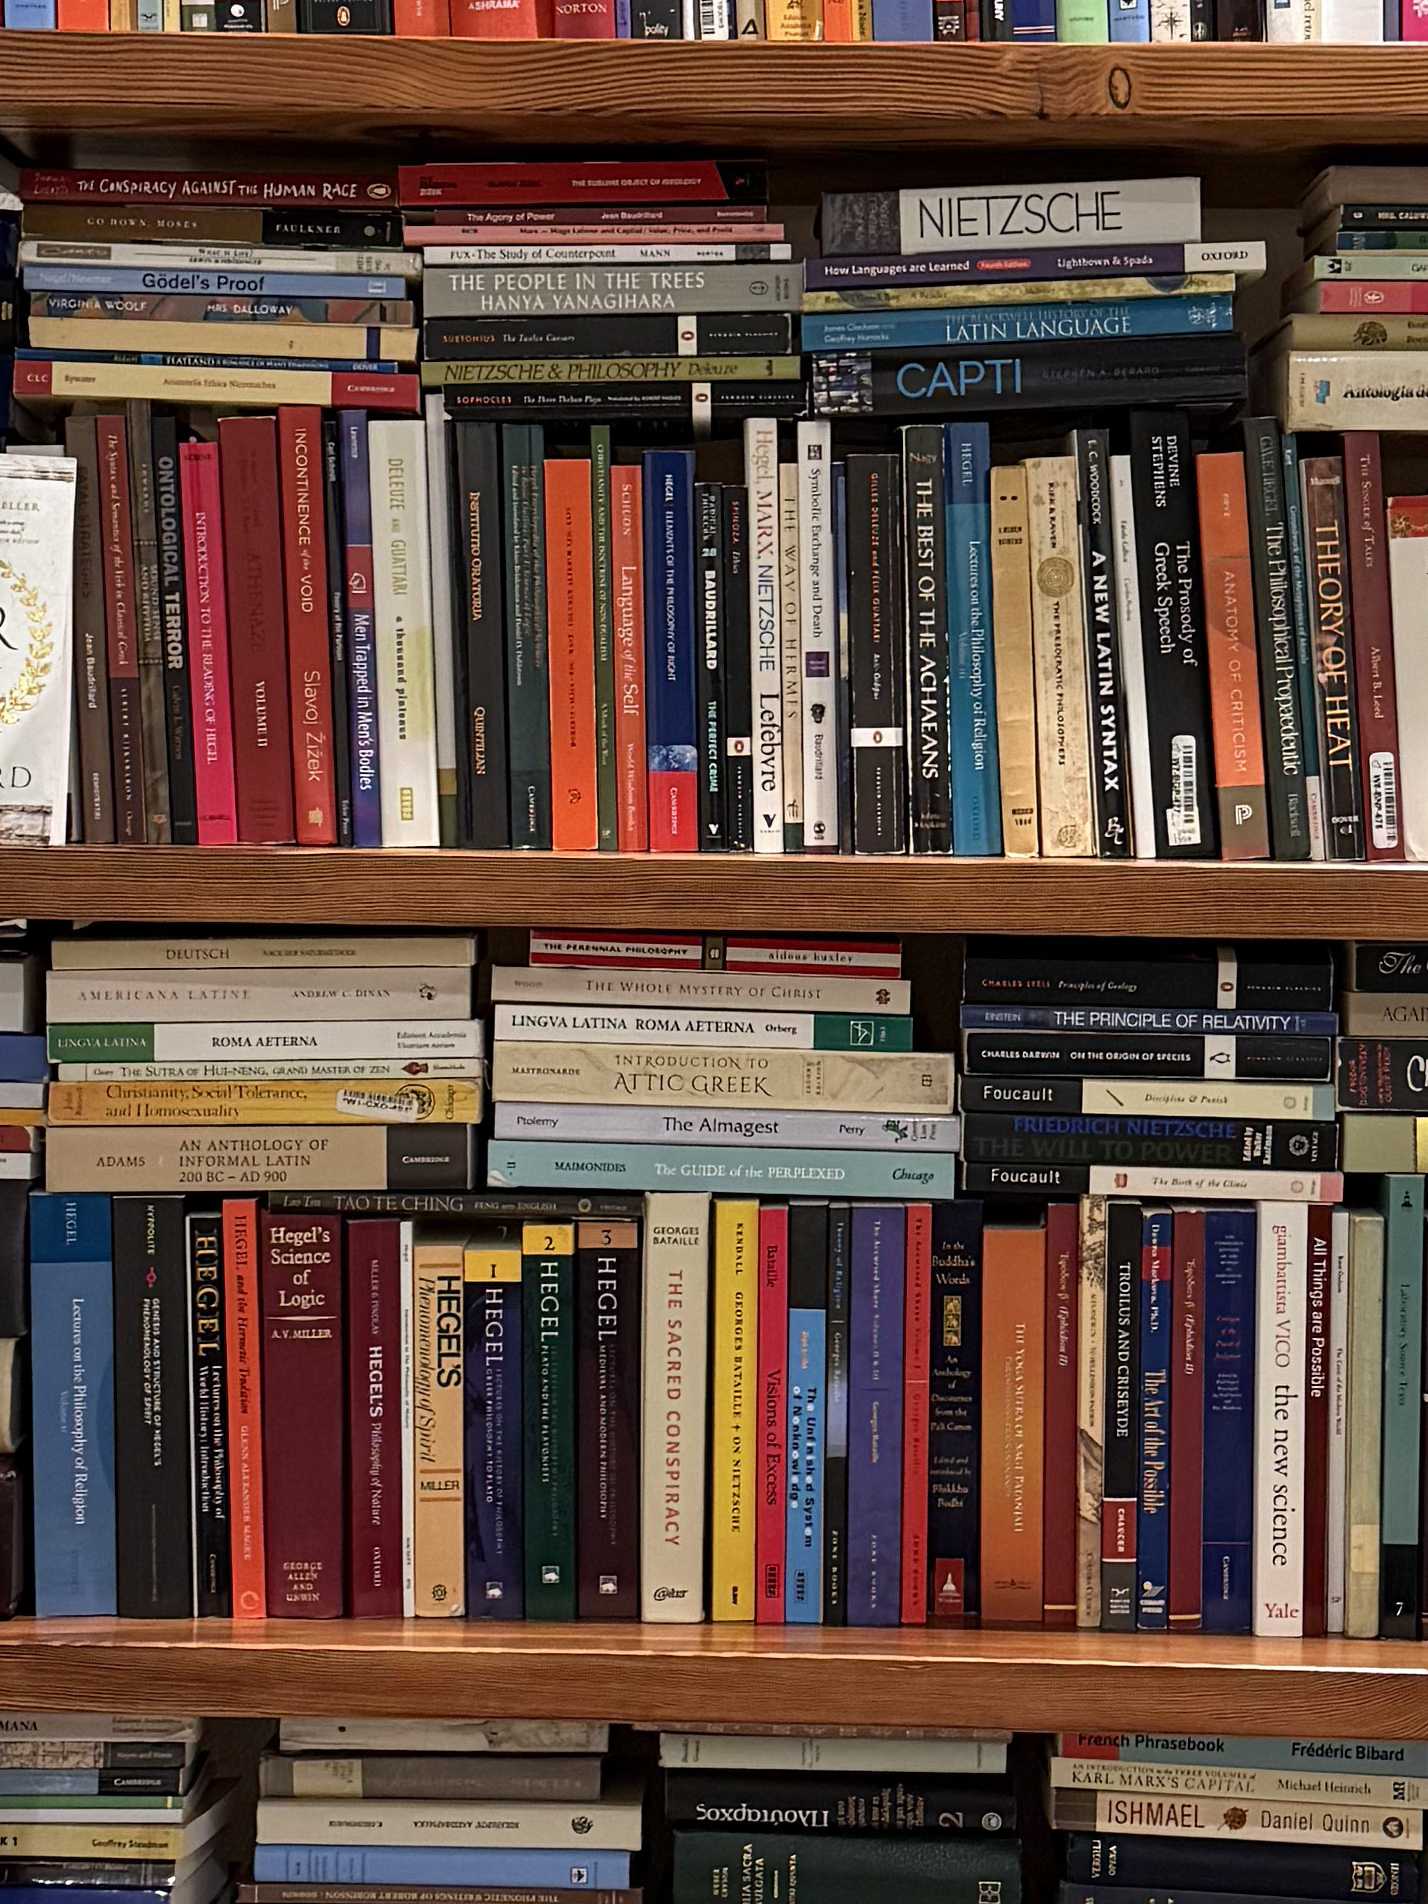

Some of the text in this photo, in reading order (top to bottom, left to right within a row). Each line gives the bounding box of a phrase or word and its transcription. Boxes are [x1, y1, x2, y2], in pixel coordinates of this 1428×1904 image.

[919, 192, 1122, 239] NIETZSCHE
[824, 260, 970, 277] How Languages are Learned
[142, 270, 265, 293] Gödel's Proof
[449, 272, 706, 291] THE PEOPLE IN THE TREES
[481, 292, 676, 311] HANYA YANAGIHARA
[897, 360, 1021, 398] CAPTI
[917, 478, 940, 780] THE BEST OF THE ACHAEANS
[1315, 522, 1350, 768] THEORY OF HEAT
[1091, 551, 1120, 792] A NEW LATIN SYNTAX
[1054, 1011, 1290, 1031] THE PRINCIPLE OF RELATIVITY
[212, 1035, 318, 1048] ROMA AETERNA
[983, 1085, 1053, 1103] Foucault
[663, 1117, 779, 1137] The Almagest
[991, 1168, 1061, 1185] Foucault
[270, 1226, 331, 1247] Hegel's
[270, 1247, 331, 1266] Science
[293, 1270, 311, 1286] of
[279, 1290, 326, 1309] Logic
[1271, 1384, 1299, 1567] the new science
[1107, 1800, 1204, 1829] ISHMAEL
